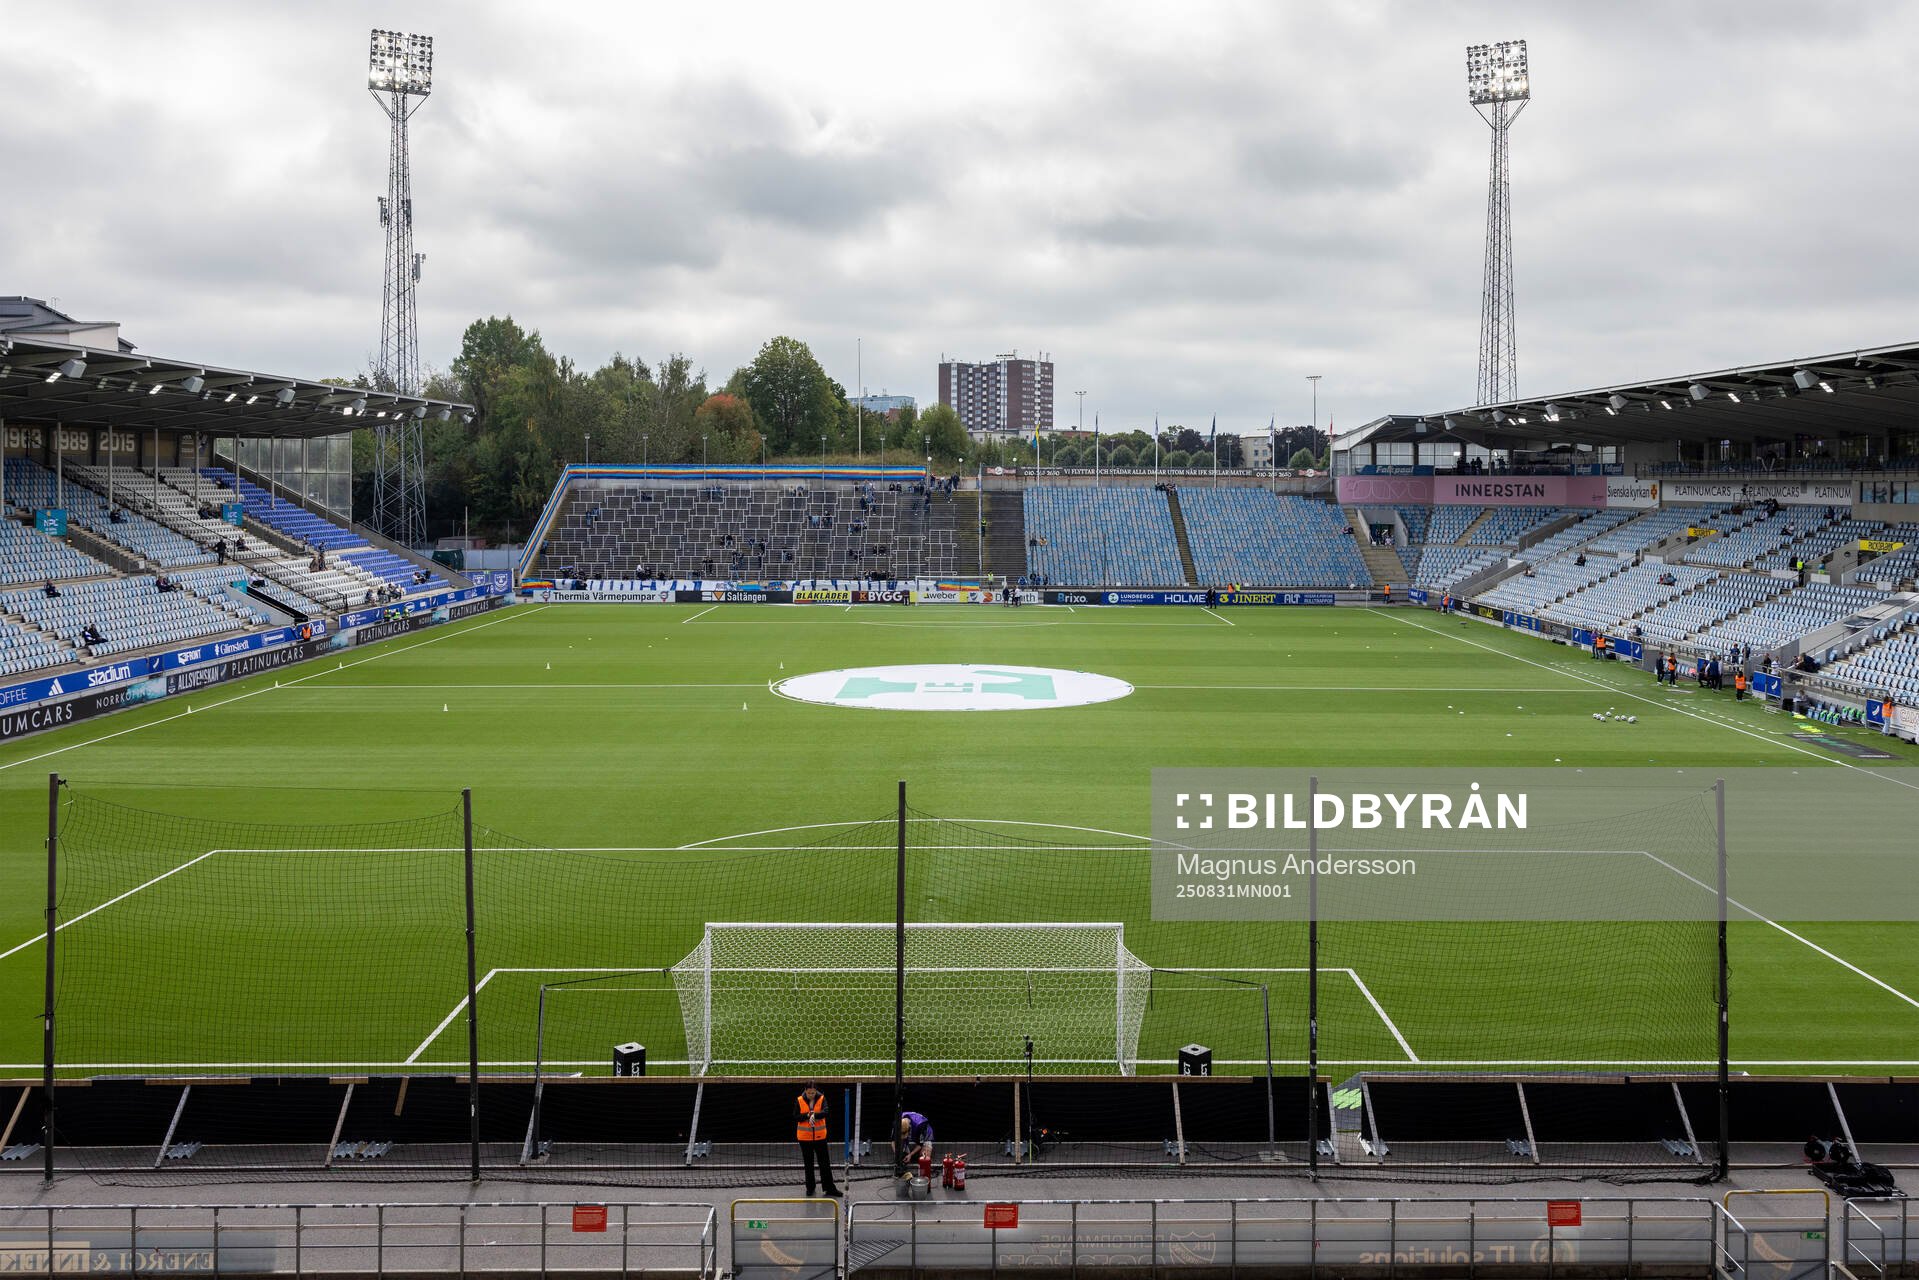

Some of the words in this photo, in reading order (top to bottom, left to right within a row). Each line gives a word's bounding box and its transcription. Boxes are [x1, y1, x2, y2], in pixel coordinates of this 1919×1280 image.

[52, 430, 89, 451] 1989
[100, 431, 135, 452] 2015
[1455, 483, 1545, 498] INNERSTAN
[1674, 486, 1732, 497] PLATINUMCARS
[1749, 486, 1800, 498] PLATINUMCARS
[1814, 488, 1851, 499] PLATINUM
[553, 592, 590, 601] Thermia
[593, 591, 656, 602] Värmepumpar
[726, 591, 767, 603] Saltängen
[796, 590, 849, 600] BLÅKLÄDER
[868, 591, 903, 602] BYGG
[928, 591, 957, 600] weber
[1057, 592, 1087, 603] Brixo
[1164, 594, 1207, 603] HOLME
[1232, 593, 1277, 604] JINERT
[450, 600, 490, 618] PLATINUMCARS
[359, 619, 411, 643] PLATINUMCARS
[231, 646, 305, 676] PLATINUMCARS
[88, 662, 131, 688] stadium
[177, 665, 220, 690] ALLSVENSKAN
[2, 703, 73, 735] UMCARS
